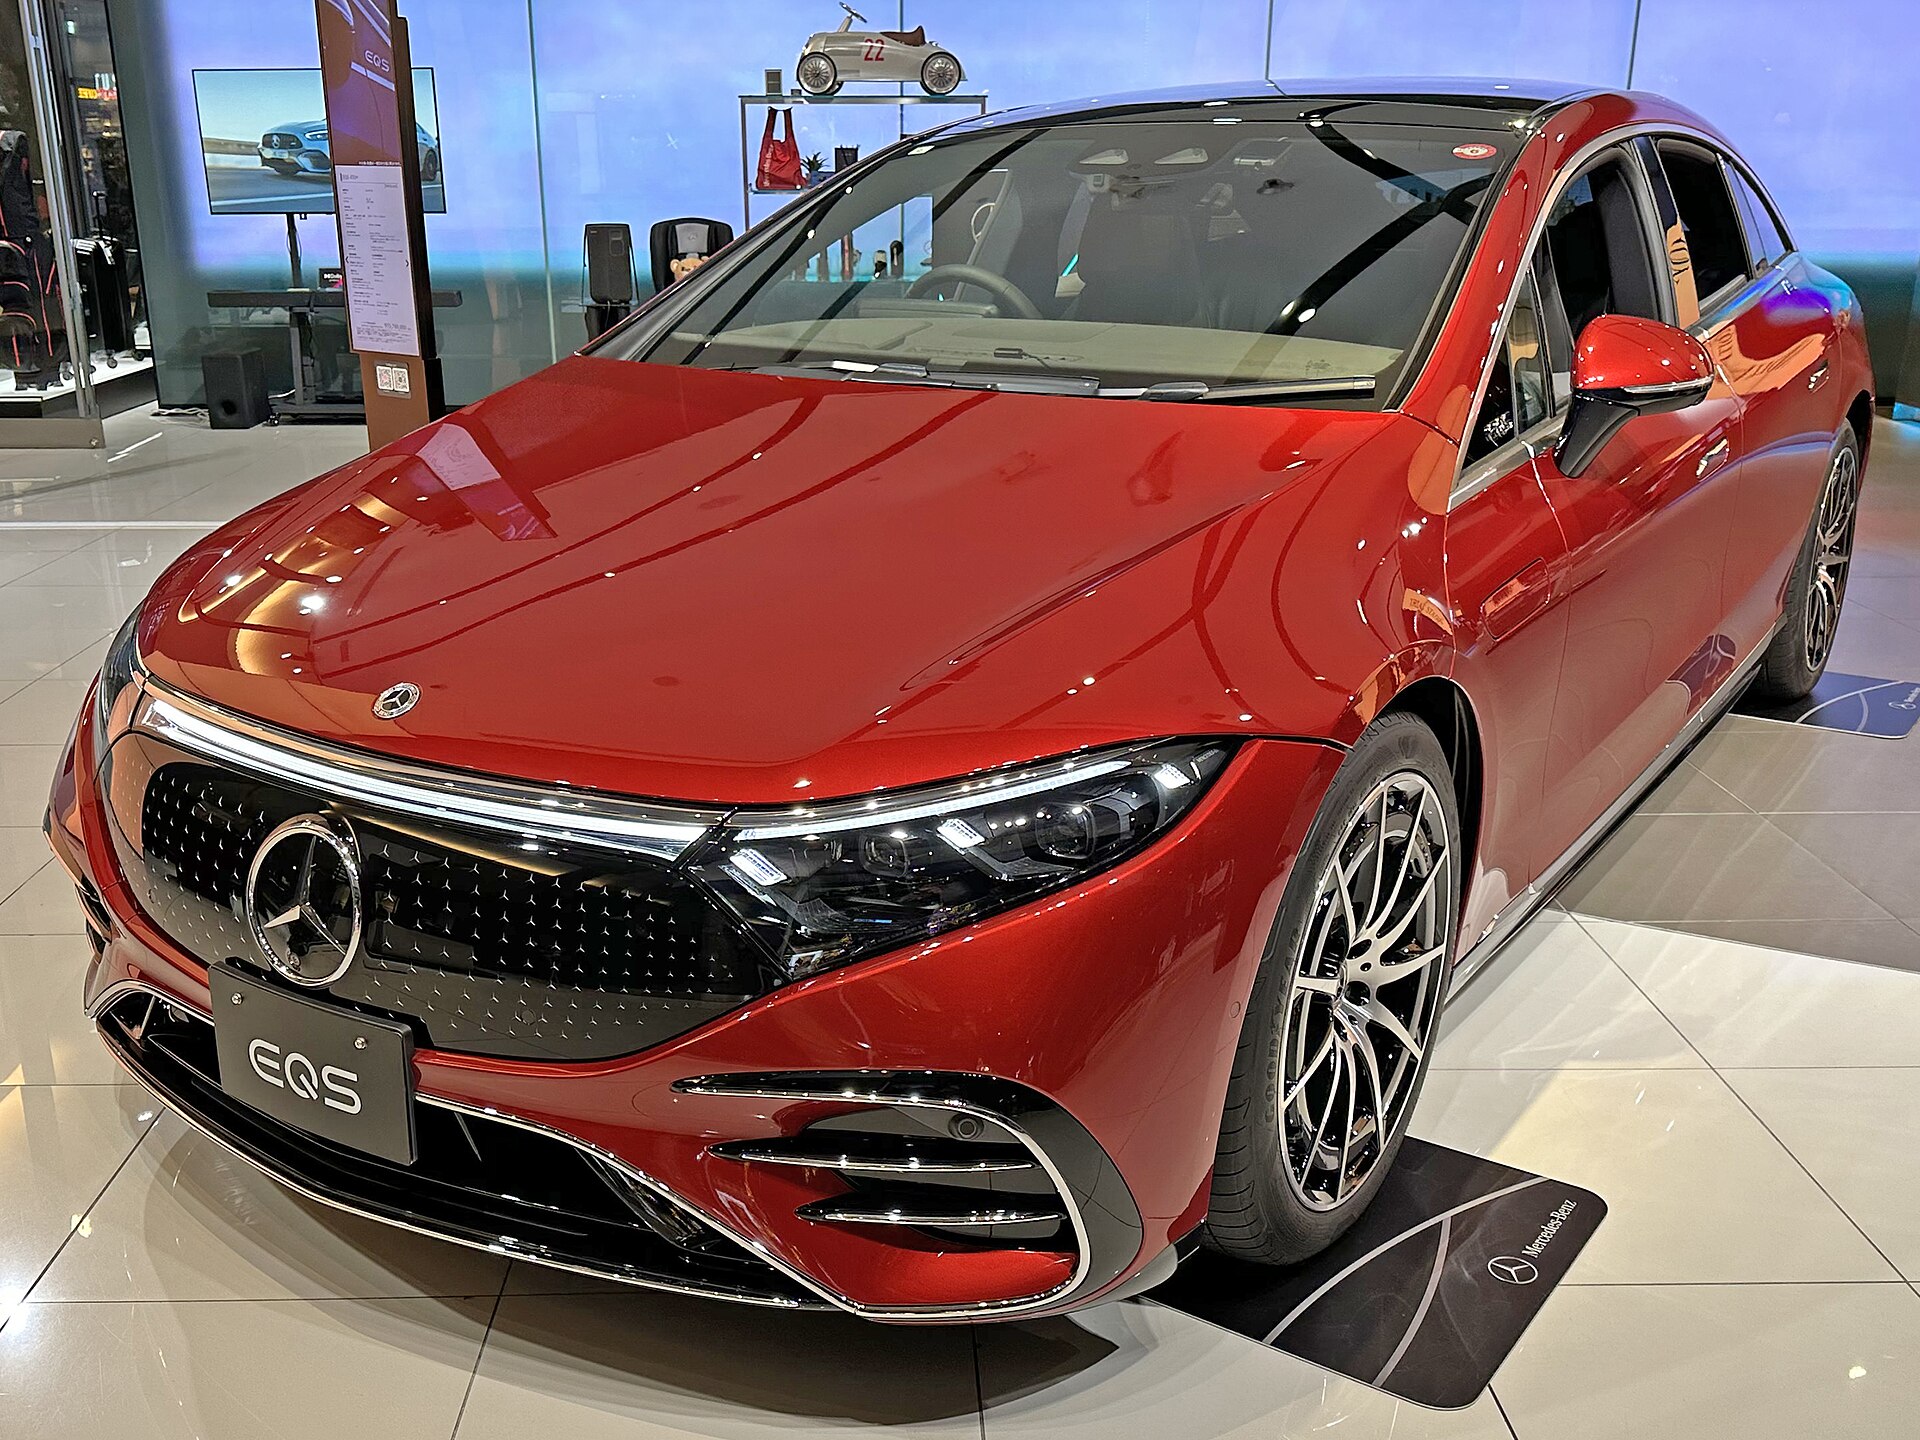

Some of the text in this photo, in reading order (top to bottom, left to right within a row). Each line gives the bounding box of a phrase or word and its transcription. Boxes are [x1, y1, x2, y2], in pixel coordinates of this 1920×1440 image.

[364, 50, 390, 72] EQS
[864, 38, 885, 62] 22
[248, 1038, 362, 1115] EQS
[1521, 1199, 1577, 1259] Mercedes-Benz
